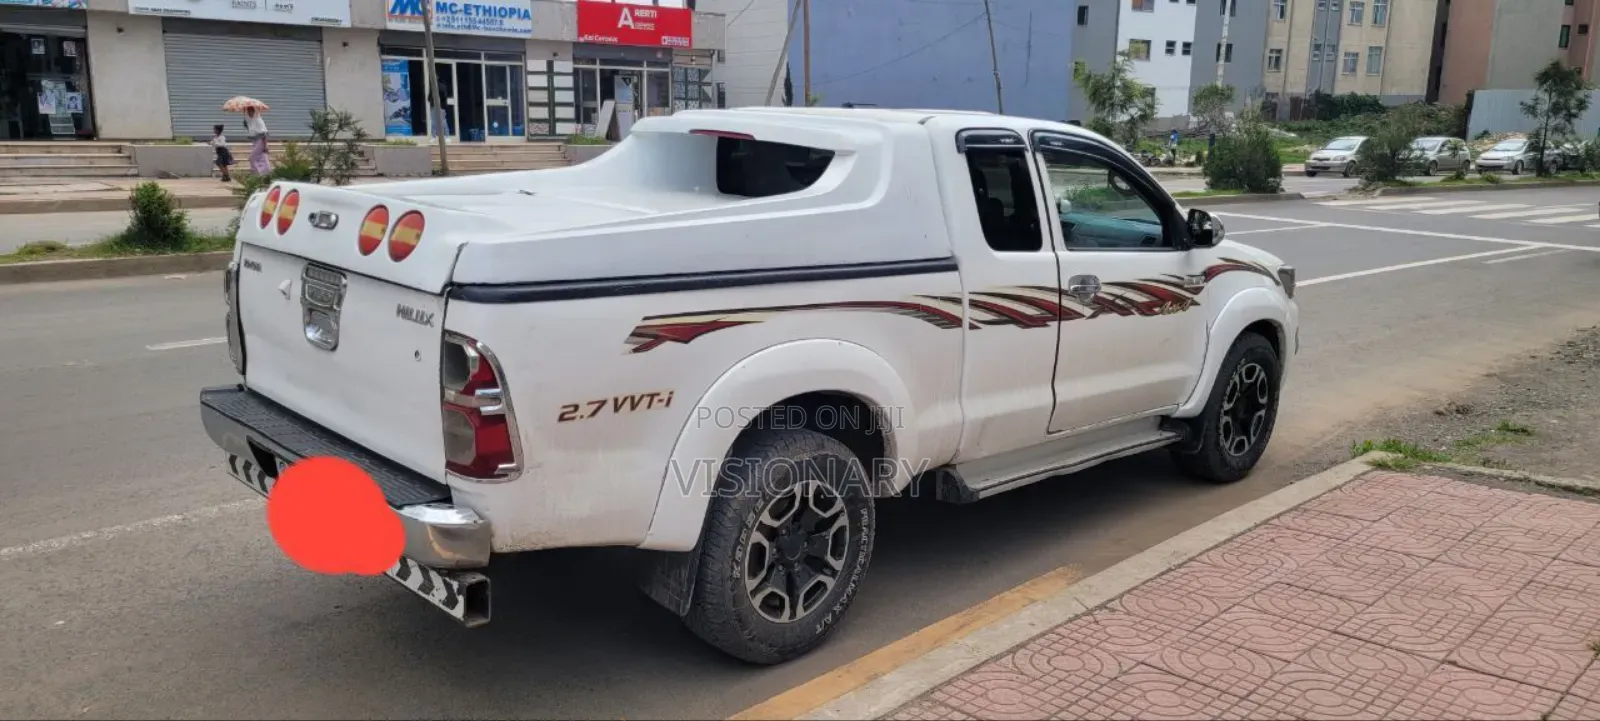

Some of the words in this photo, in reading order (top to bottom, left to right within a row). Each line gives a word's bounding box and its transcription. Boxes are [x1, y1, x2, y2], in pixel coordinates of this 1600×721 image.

[435, 2, 532, 20] MC-ETHIOPIA
[617, 7, 635, 29] A
[396, 303, 435, 328] HILUX
[557, 398, 608, 423] 2.7
[612, 390, 675, 414] VVT-i
